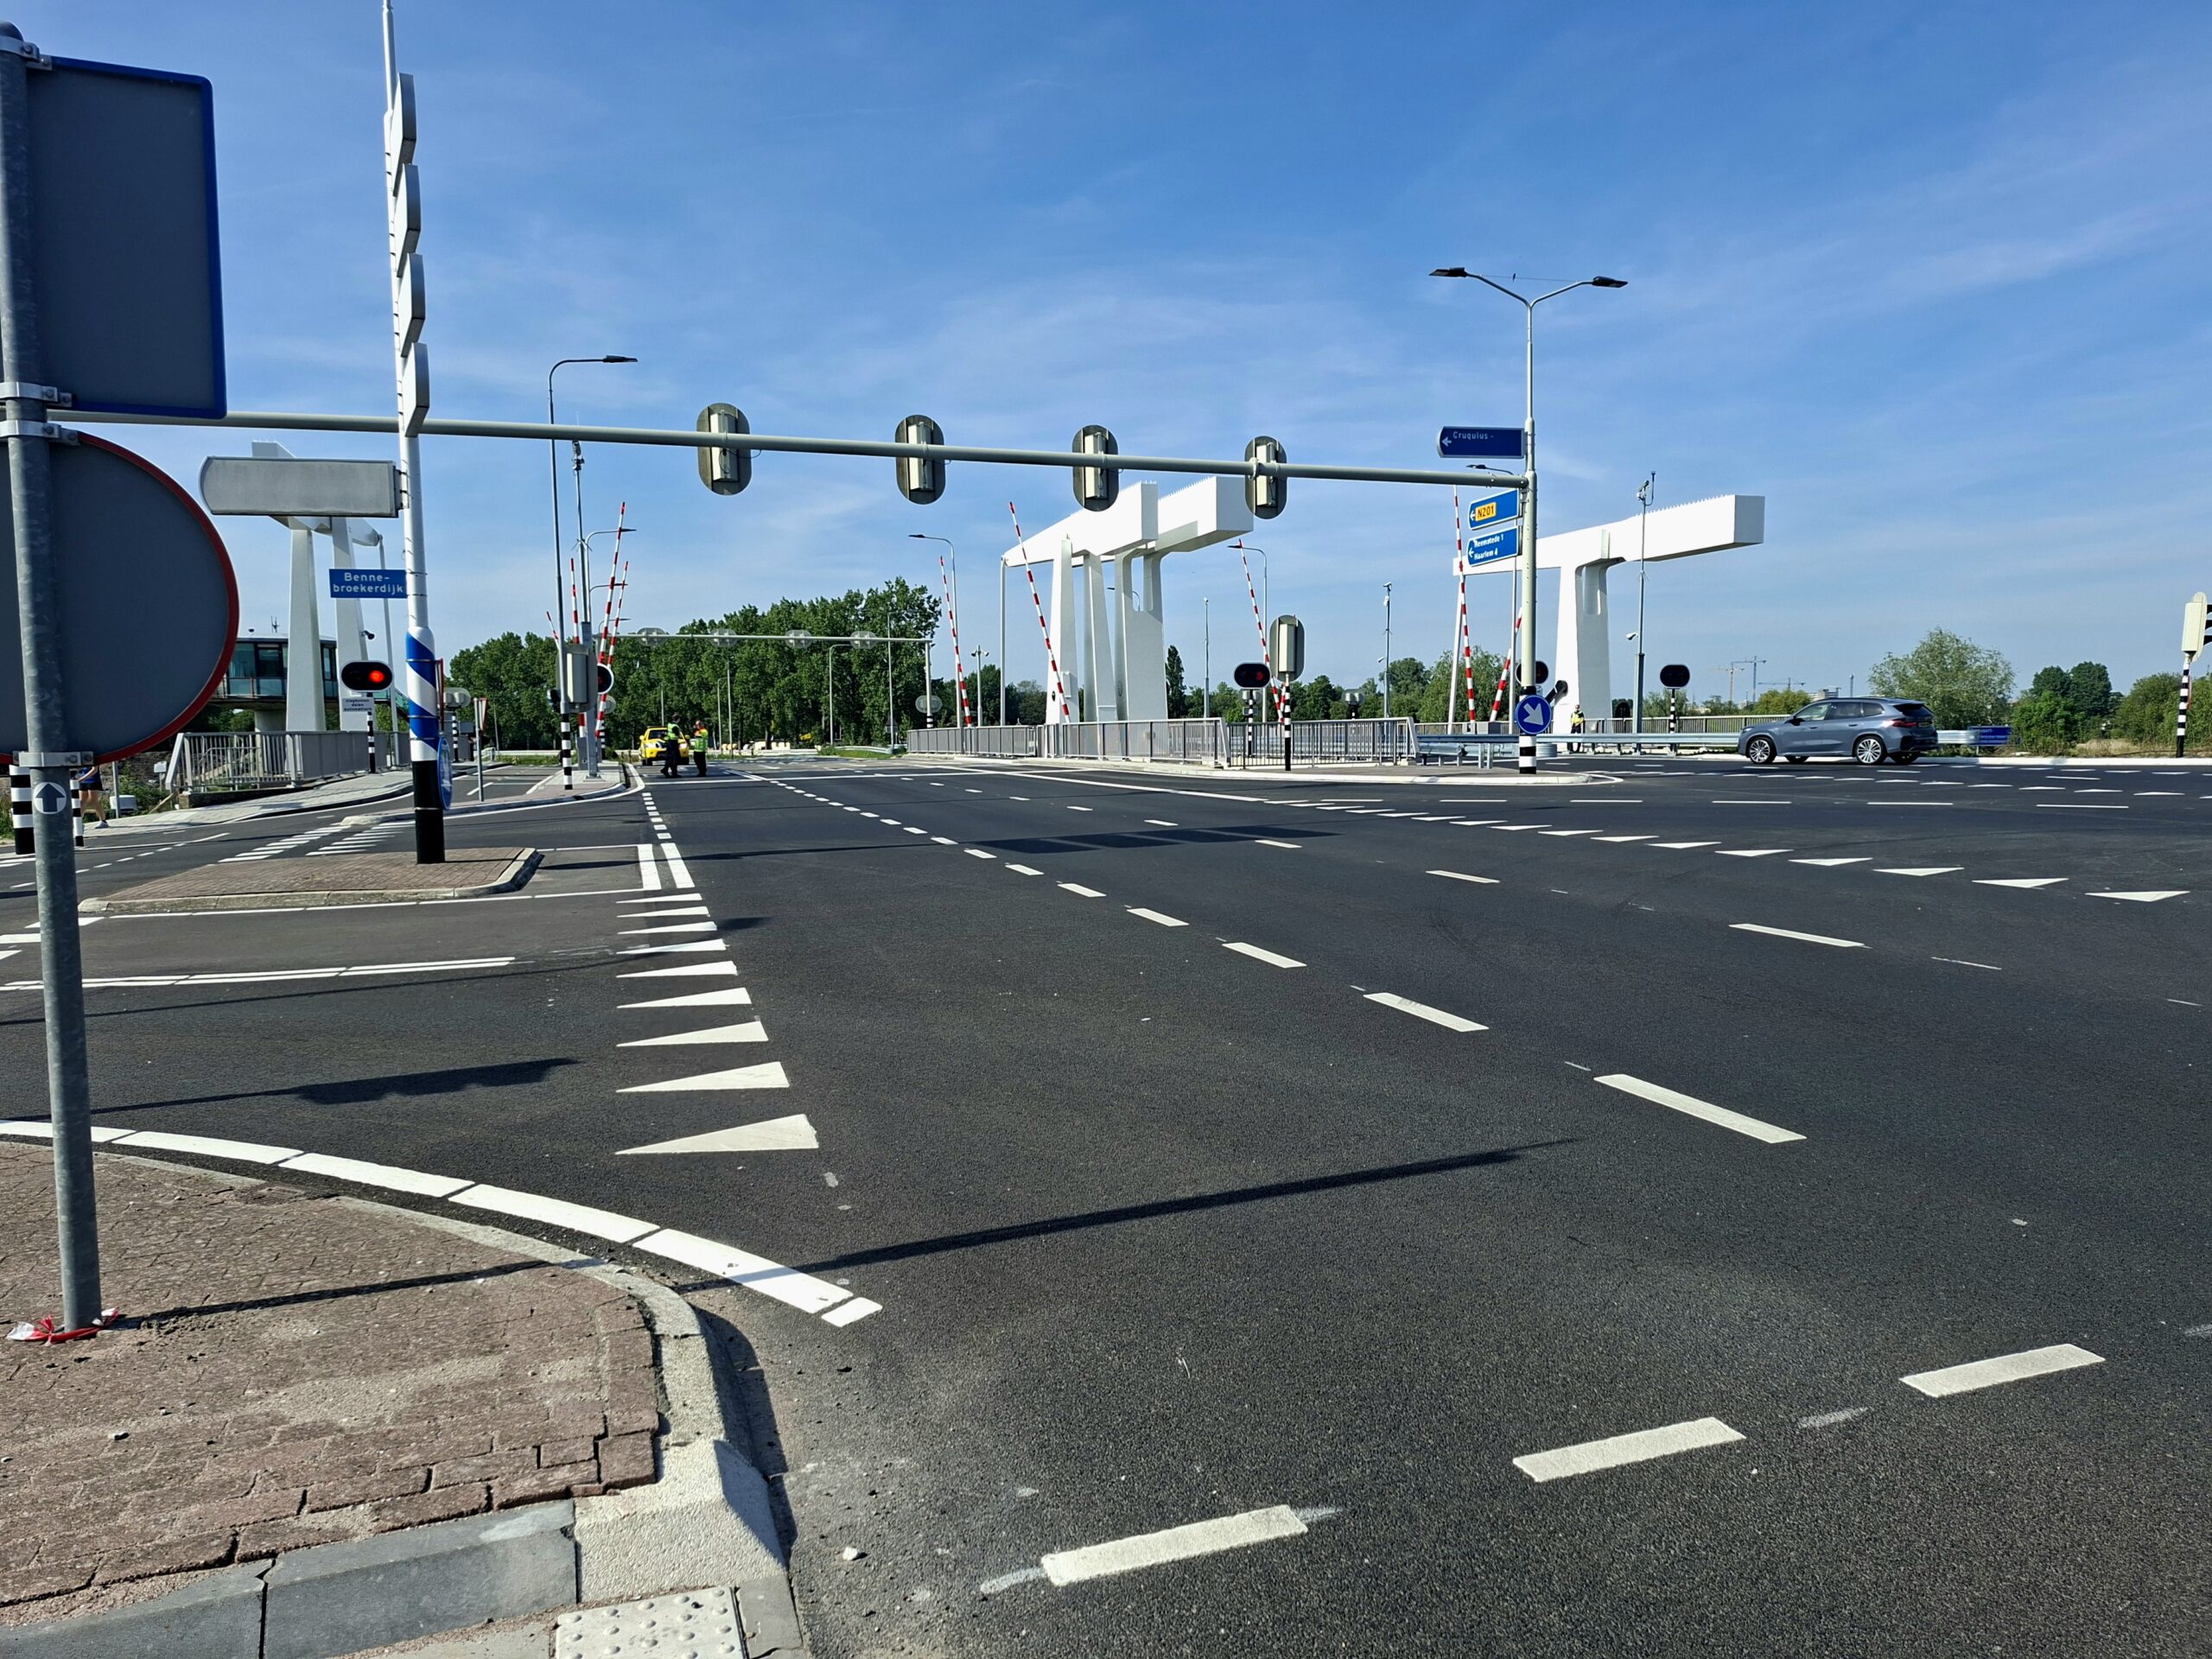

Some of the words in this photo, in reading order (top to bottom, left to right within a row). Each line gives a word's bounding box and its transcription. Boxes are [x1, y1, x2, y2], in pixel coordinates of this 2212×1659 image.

[1478, 505, 1494, 518] N201
[1474, 550, 1494, 561] Haarlem
[344, 572, 390, 582] Benne-
[333, 583, 404, 595] broekerdijk
